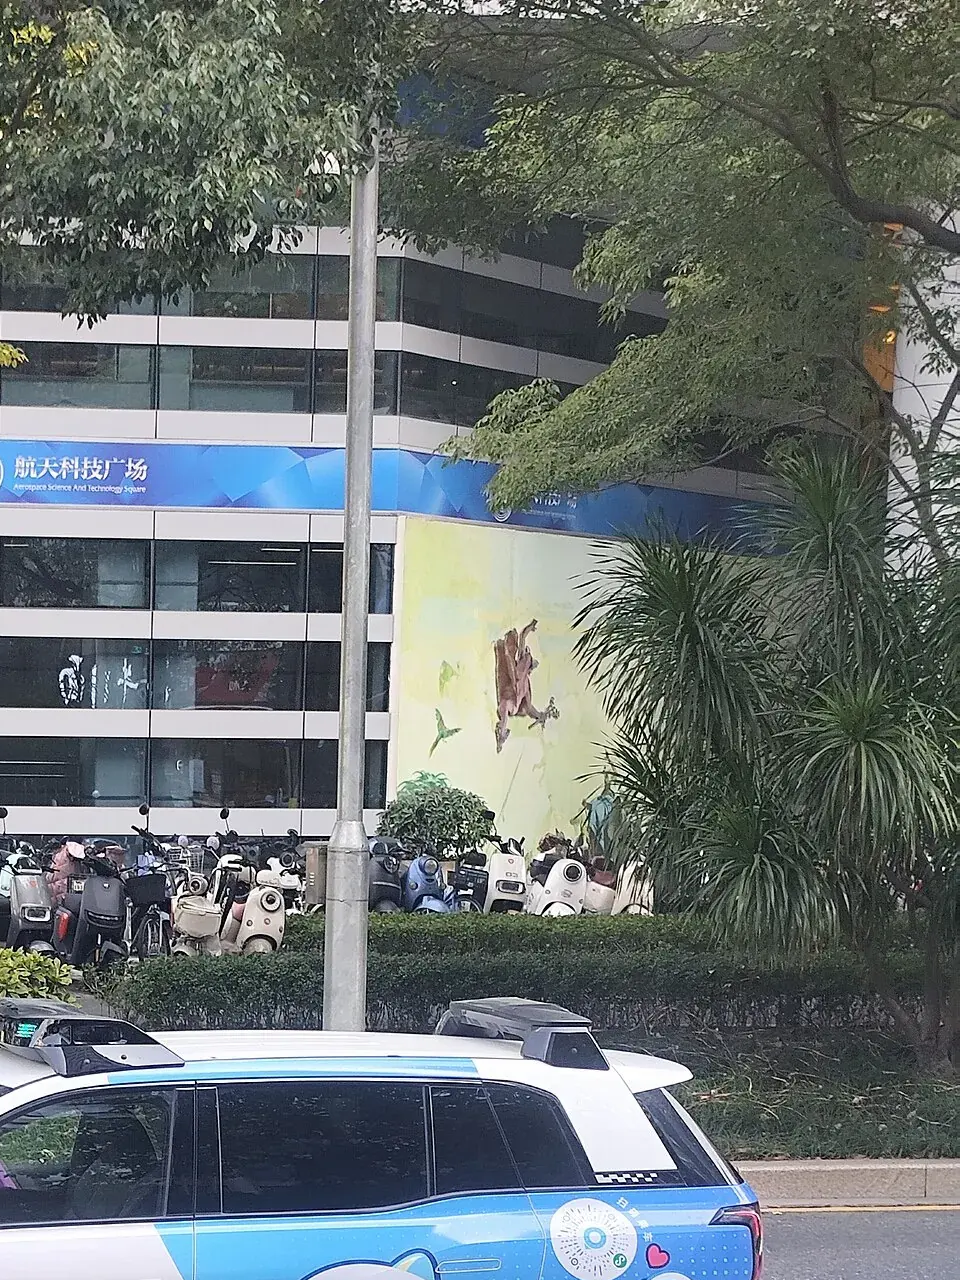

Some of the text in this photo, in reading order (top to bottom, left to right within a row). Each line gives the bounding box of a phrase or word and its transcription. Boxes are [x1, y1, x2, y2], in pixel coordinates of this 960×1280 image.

[13, 455, 147, 481] 航天科技广场
[14, 484, 146, 495] Aerospace Science And Technology Square
